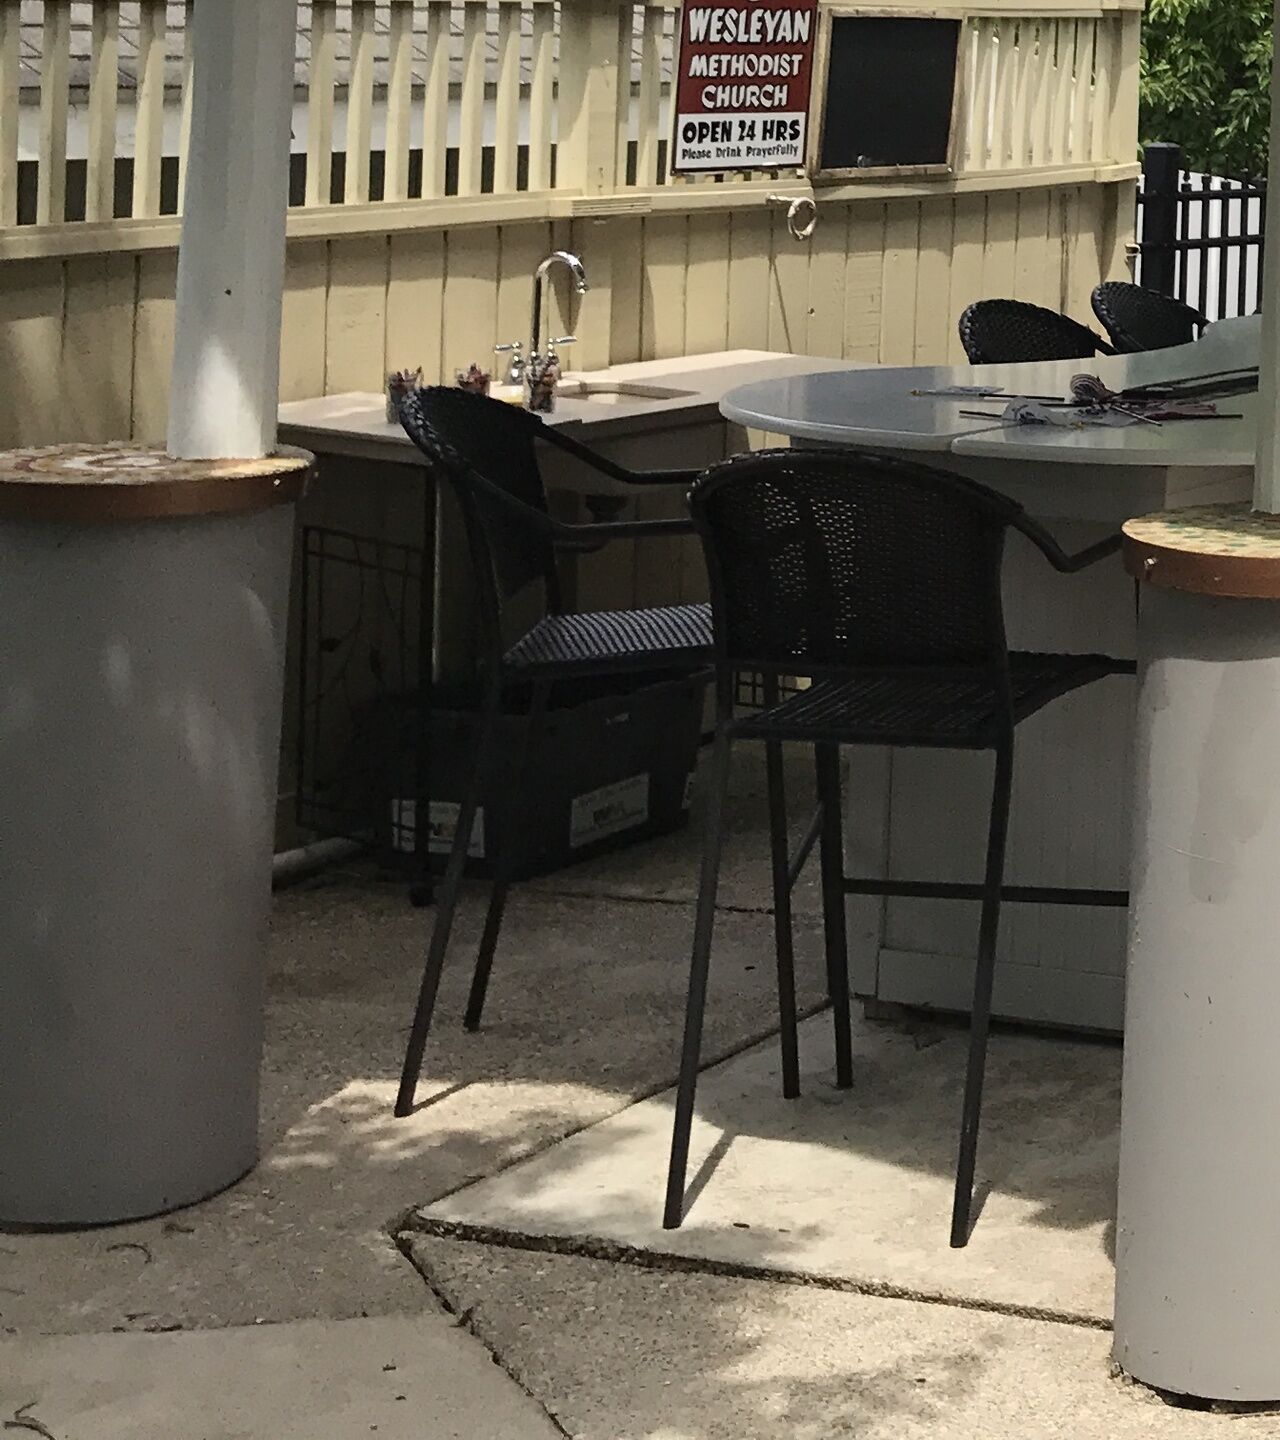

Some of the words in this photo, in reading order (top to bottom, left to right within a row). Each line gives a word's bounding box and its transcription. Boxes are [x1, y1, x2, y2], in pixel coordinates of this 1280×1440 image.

[688, 7, 811, 43] WESLEYAN
[688, 53, 803, 77] METHODIST
[701, 84, 789, 109] CHURCH
[682, 120, 733, 144] OPEN
[738, 119, 757, 142] 24
[761, 119, 801, 141] HRS
[681, 147, 712, 160] Please
[715, 145, 742, 158] Drink
[745, 143, 799, 158] Prayerfully
